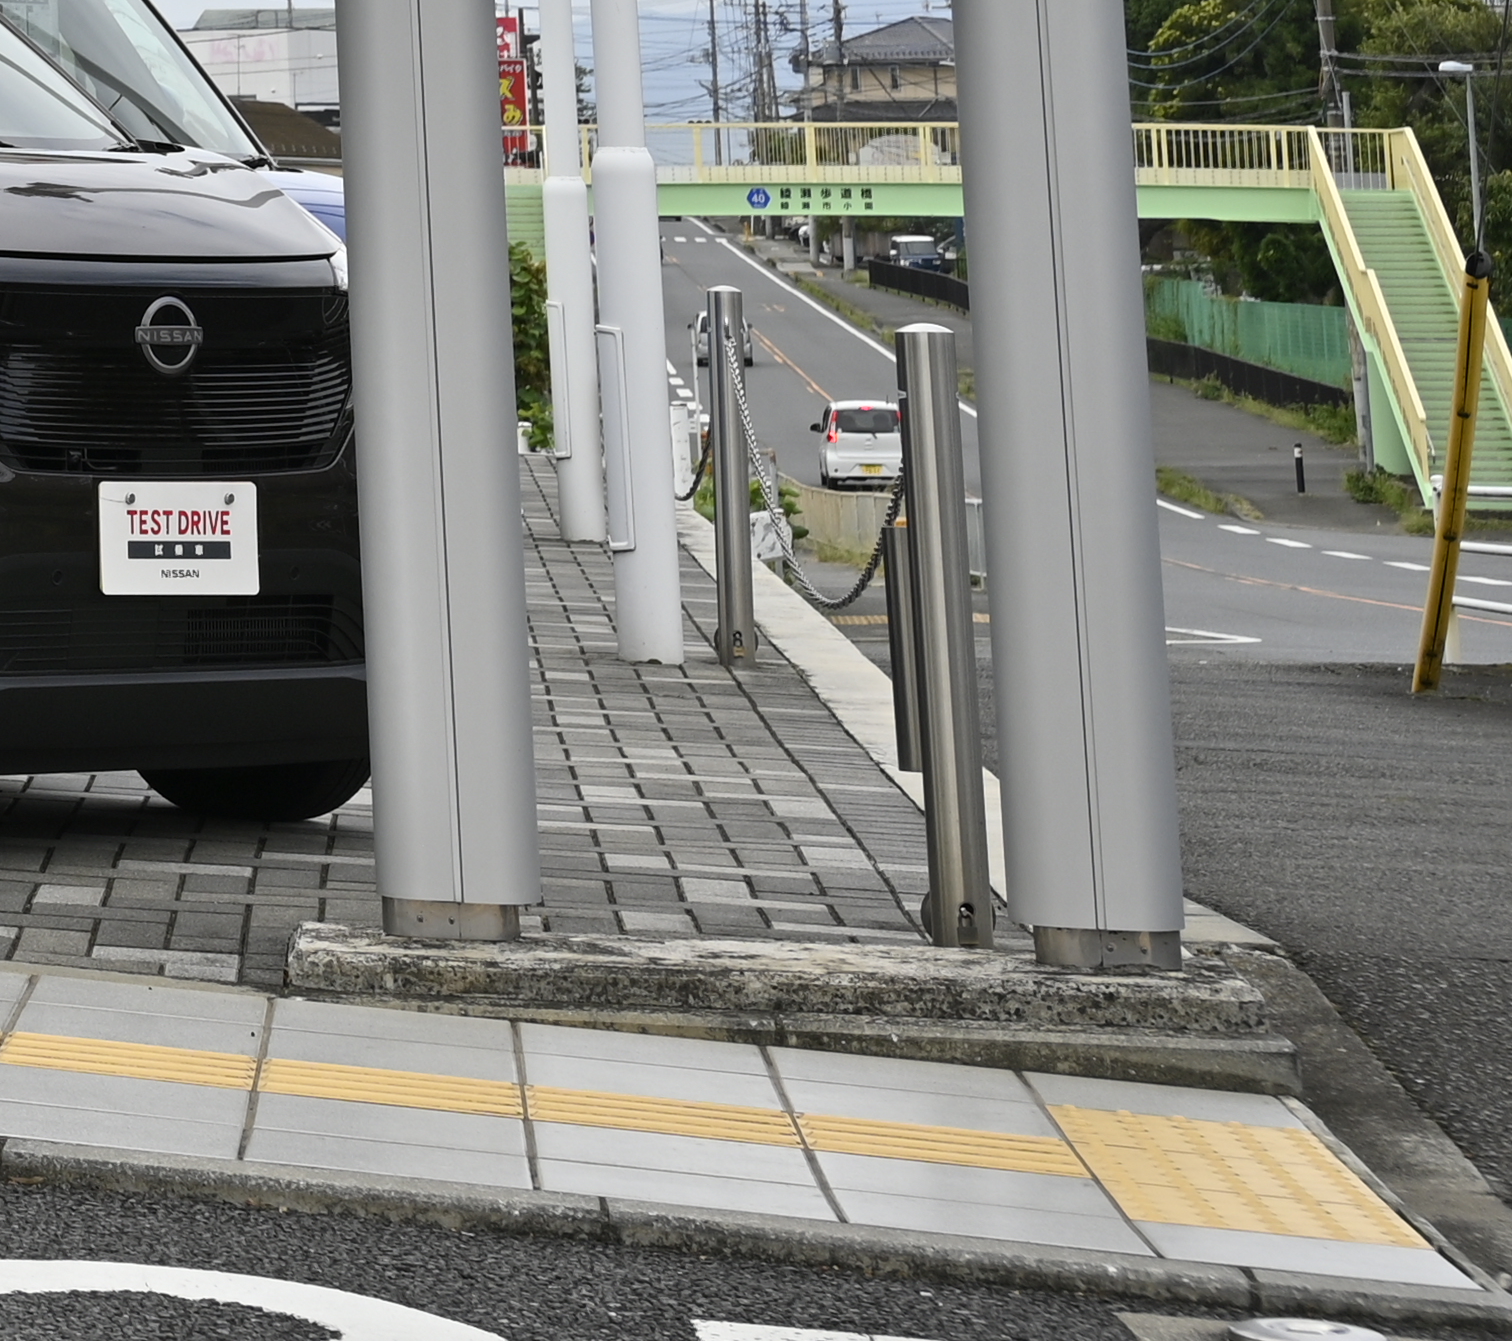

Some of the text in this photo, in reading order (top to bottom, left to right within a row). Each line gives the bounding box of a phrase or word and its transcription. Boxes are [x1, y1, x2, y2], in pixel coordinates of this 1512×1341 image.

[751, 193, 765, 203] 40
[137, 330, 202, 342] NISSAN
[127, 510, 231, 535] TEST DRIVE
[161, 569, 200, 578] NISSAN
